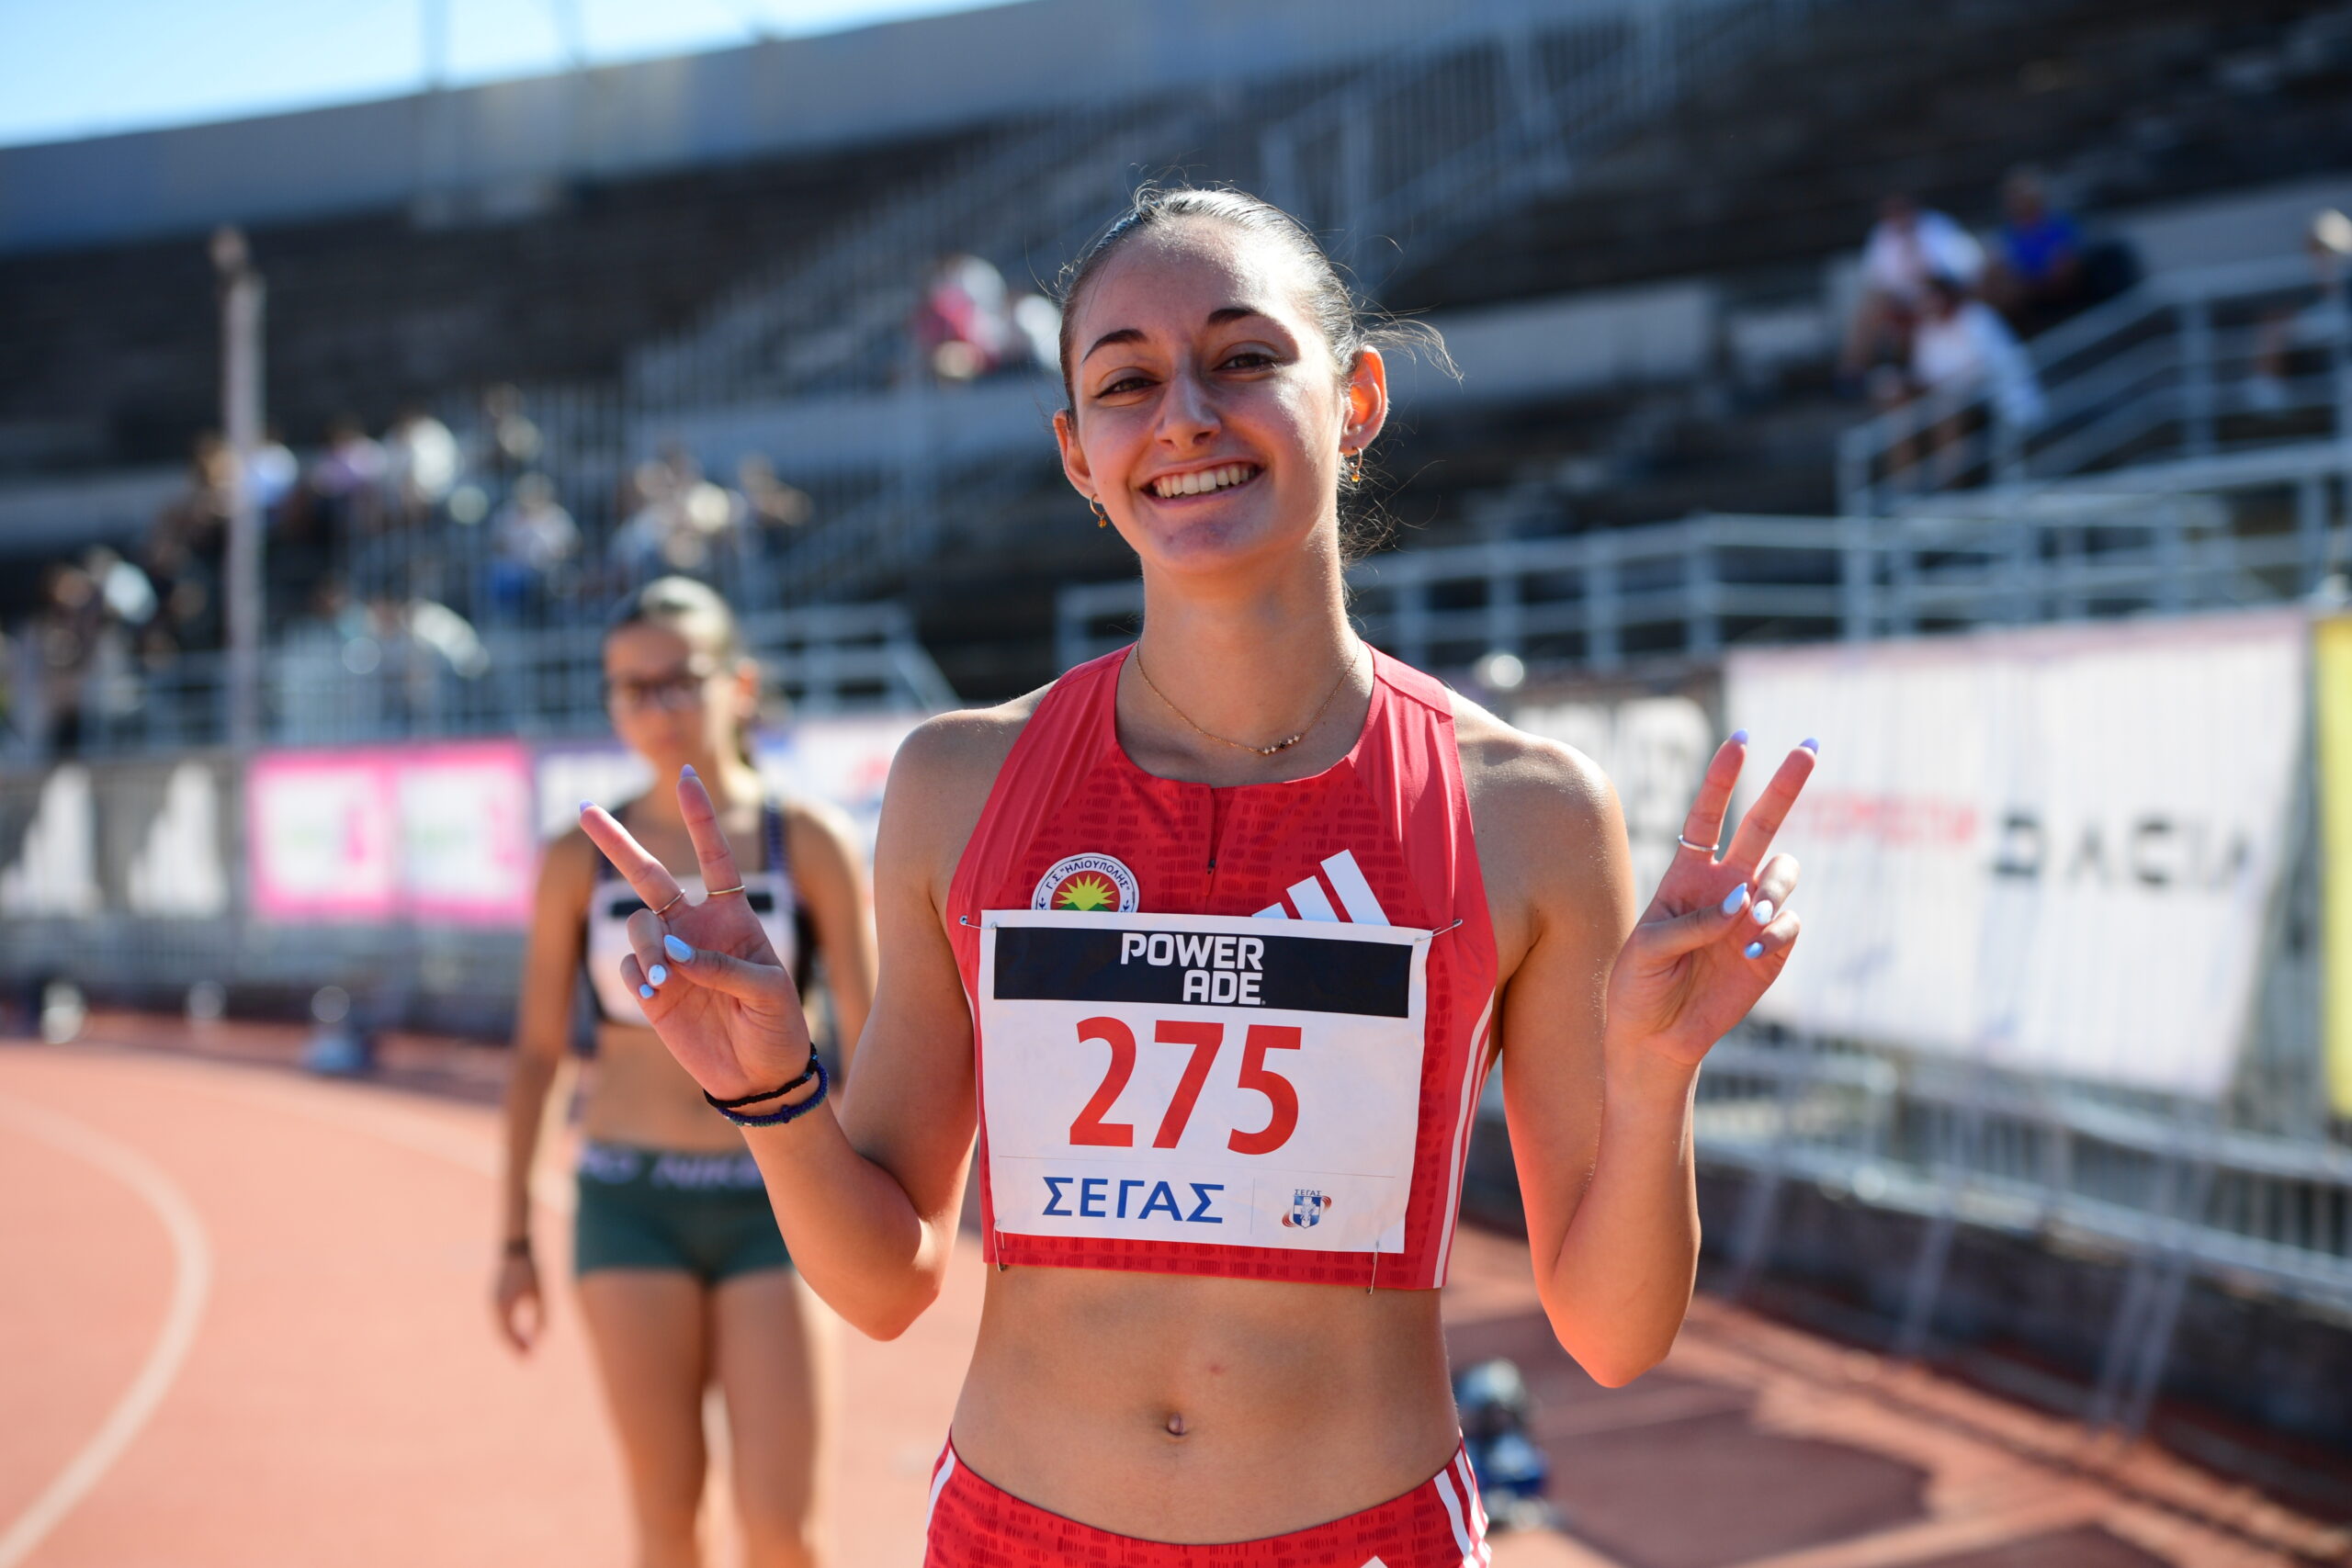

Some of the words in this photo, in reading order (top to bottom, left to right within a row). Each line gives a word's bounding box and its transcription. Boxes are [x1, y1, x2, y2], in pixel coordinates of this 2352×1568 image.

[1120, 932, 1265, 971] POWER
[1182, 969, 1263, 1006] ADE
[1069, 1016, 1302, 1156] 275
[1042, 1177, 1225, 1224] ΣΕΓΑΣ
[1294, 1189, 1322, 1197] ΣΕΓΑΣ
